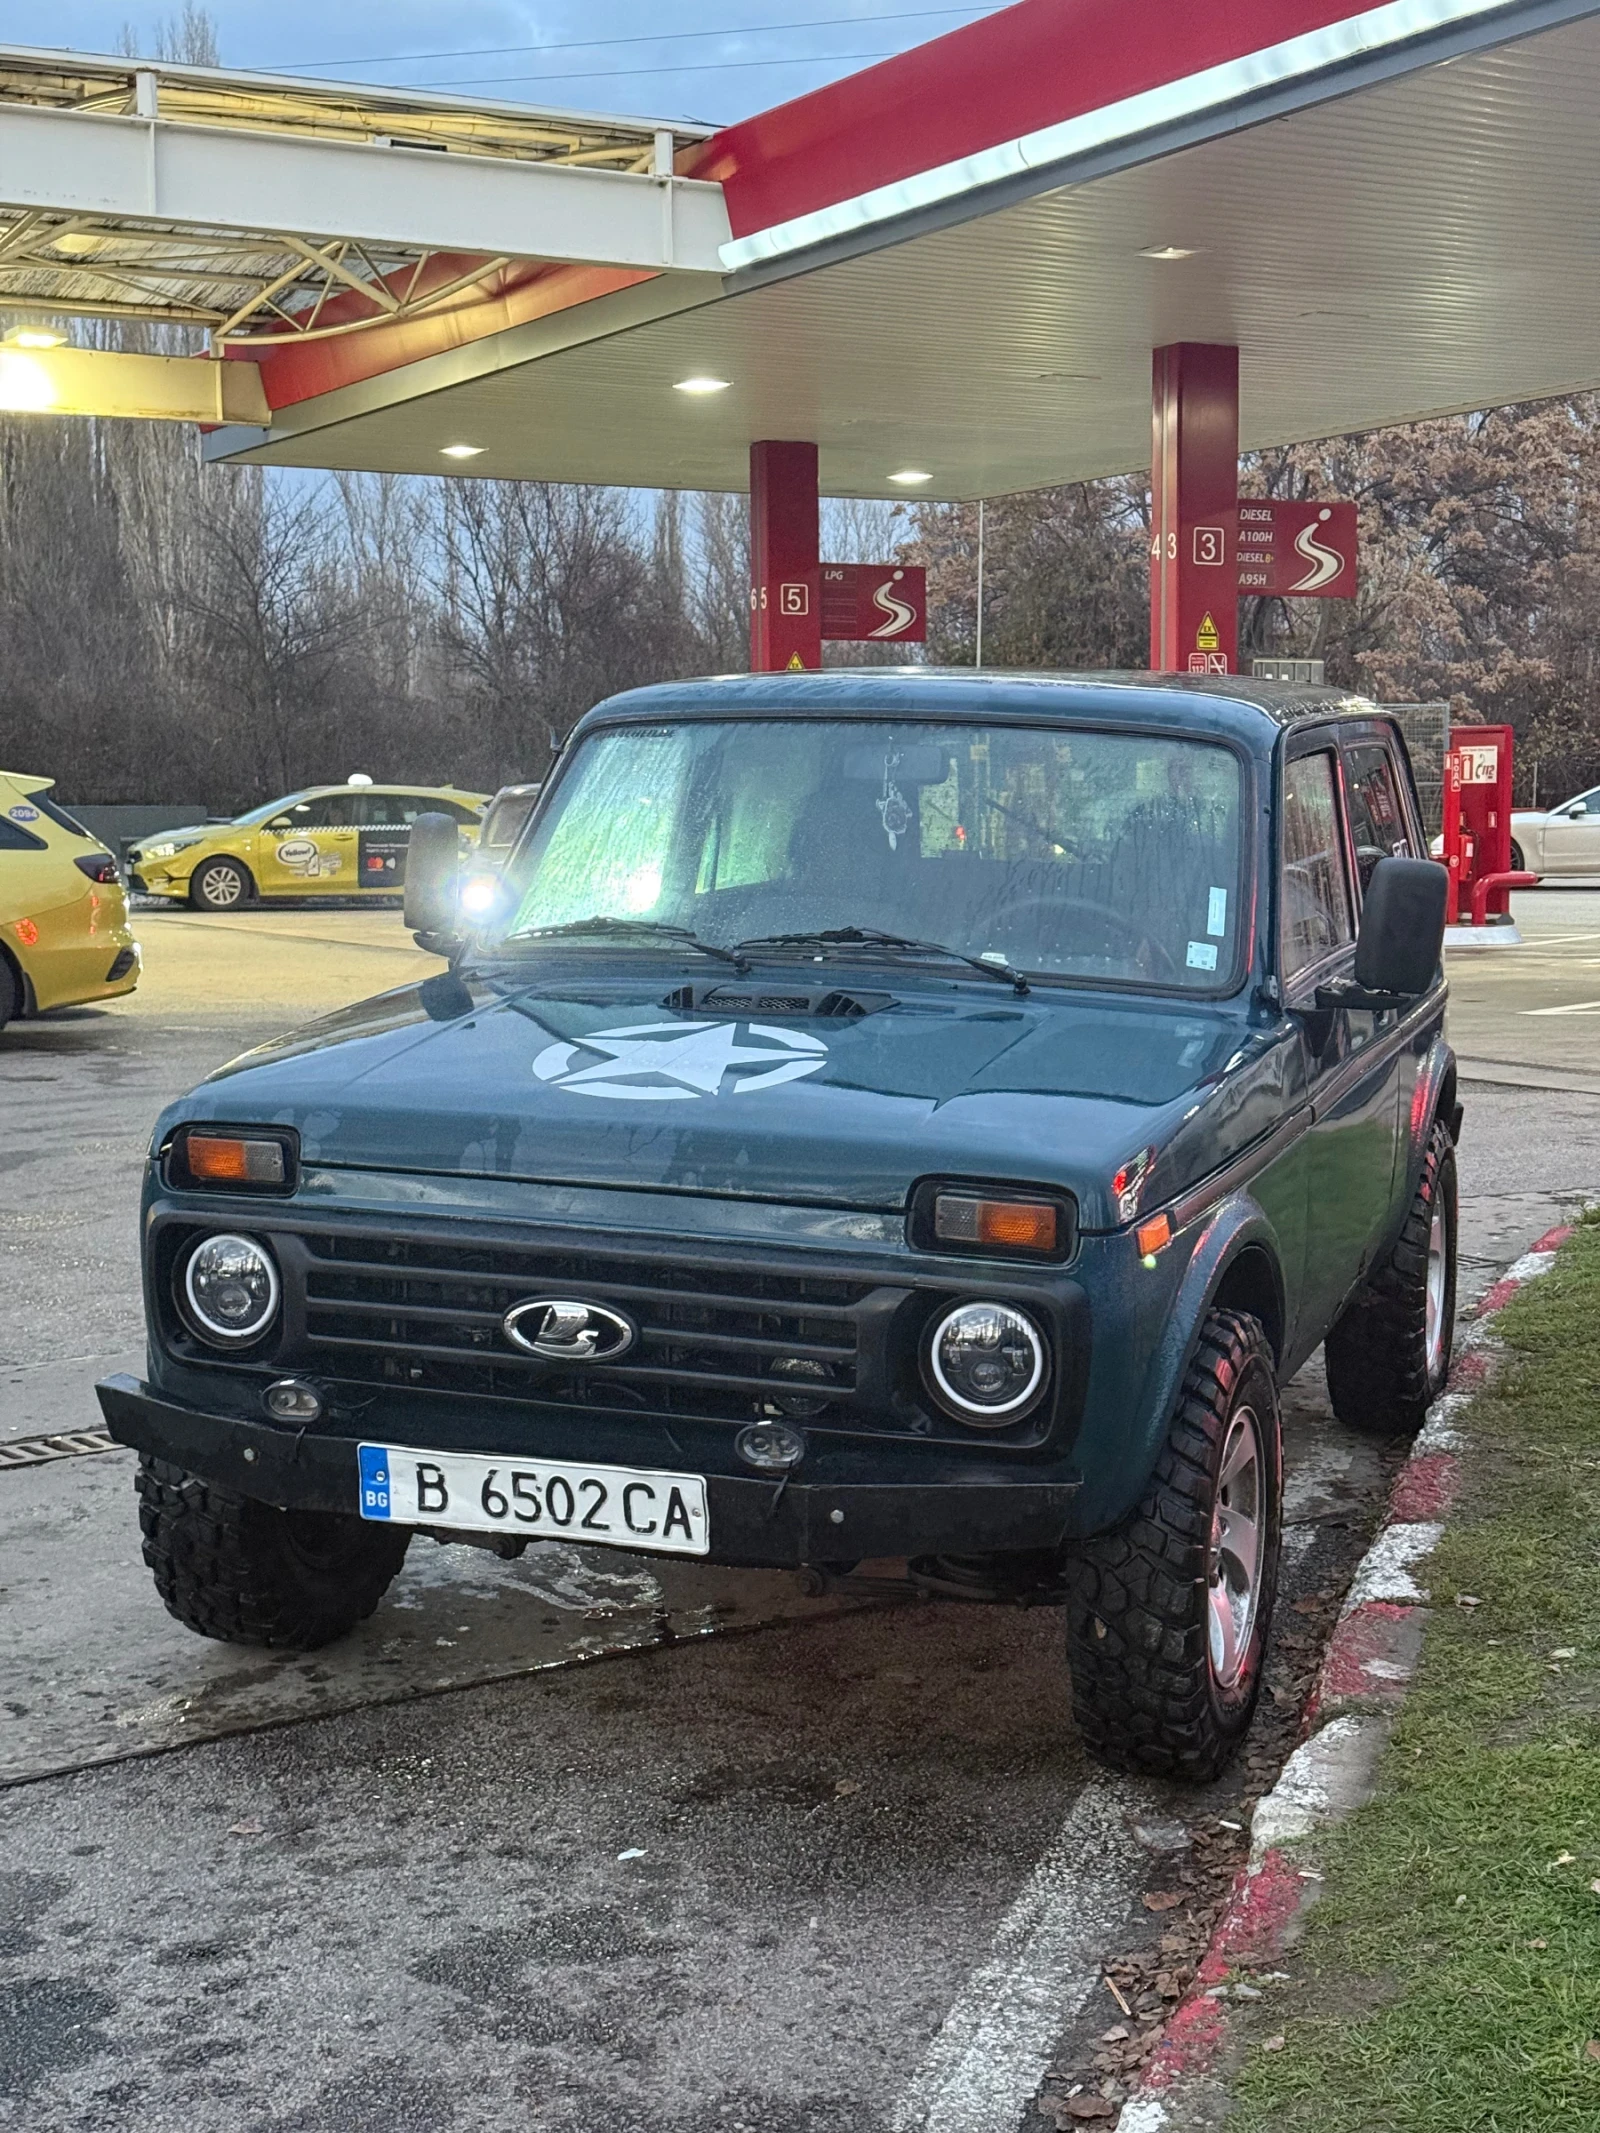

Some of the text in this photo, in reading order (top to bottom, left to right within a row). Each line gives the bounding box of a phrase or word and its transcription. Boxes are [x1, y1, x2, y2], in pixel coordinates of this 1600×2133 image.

[1239, 508, 1273, 522] DIESEL
[1151, 534, 1161, 560] 4
[1167, 532, 1177, 559] 3
[1201, 533, 1216, 560] 3
[1238, 531, 1273, 543] A100H
[1236, 552, 1264, 563] DIESEL
[824, 570, 844, 581] LPG
[1238, 573, 1267, 586] A95H
[751, 588, 757, 610] 6
[760, 586, 767, 610] 5
[787, 588, 801, 611] 5
[1482, 764, 1495, 776] 112
[365, 1489, 388, 1508] BG
[415, 1461, 694, 1542] B 6502 CA
